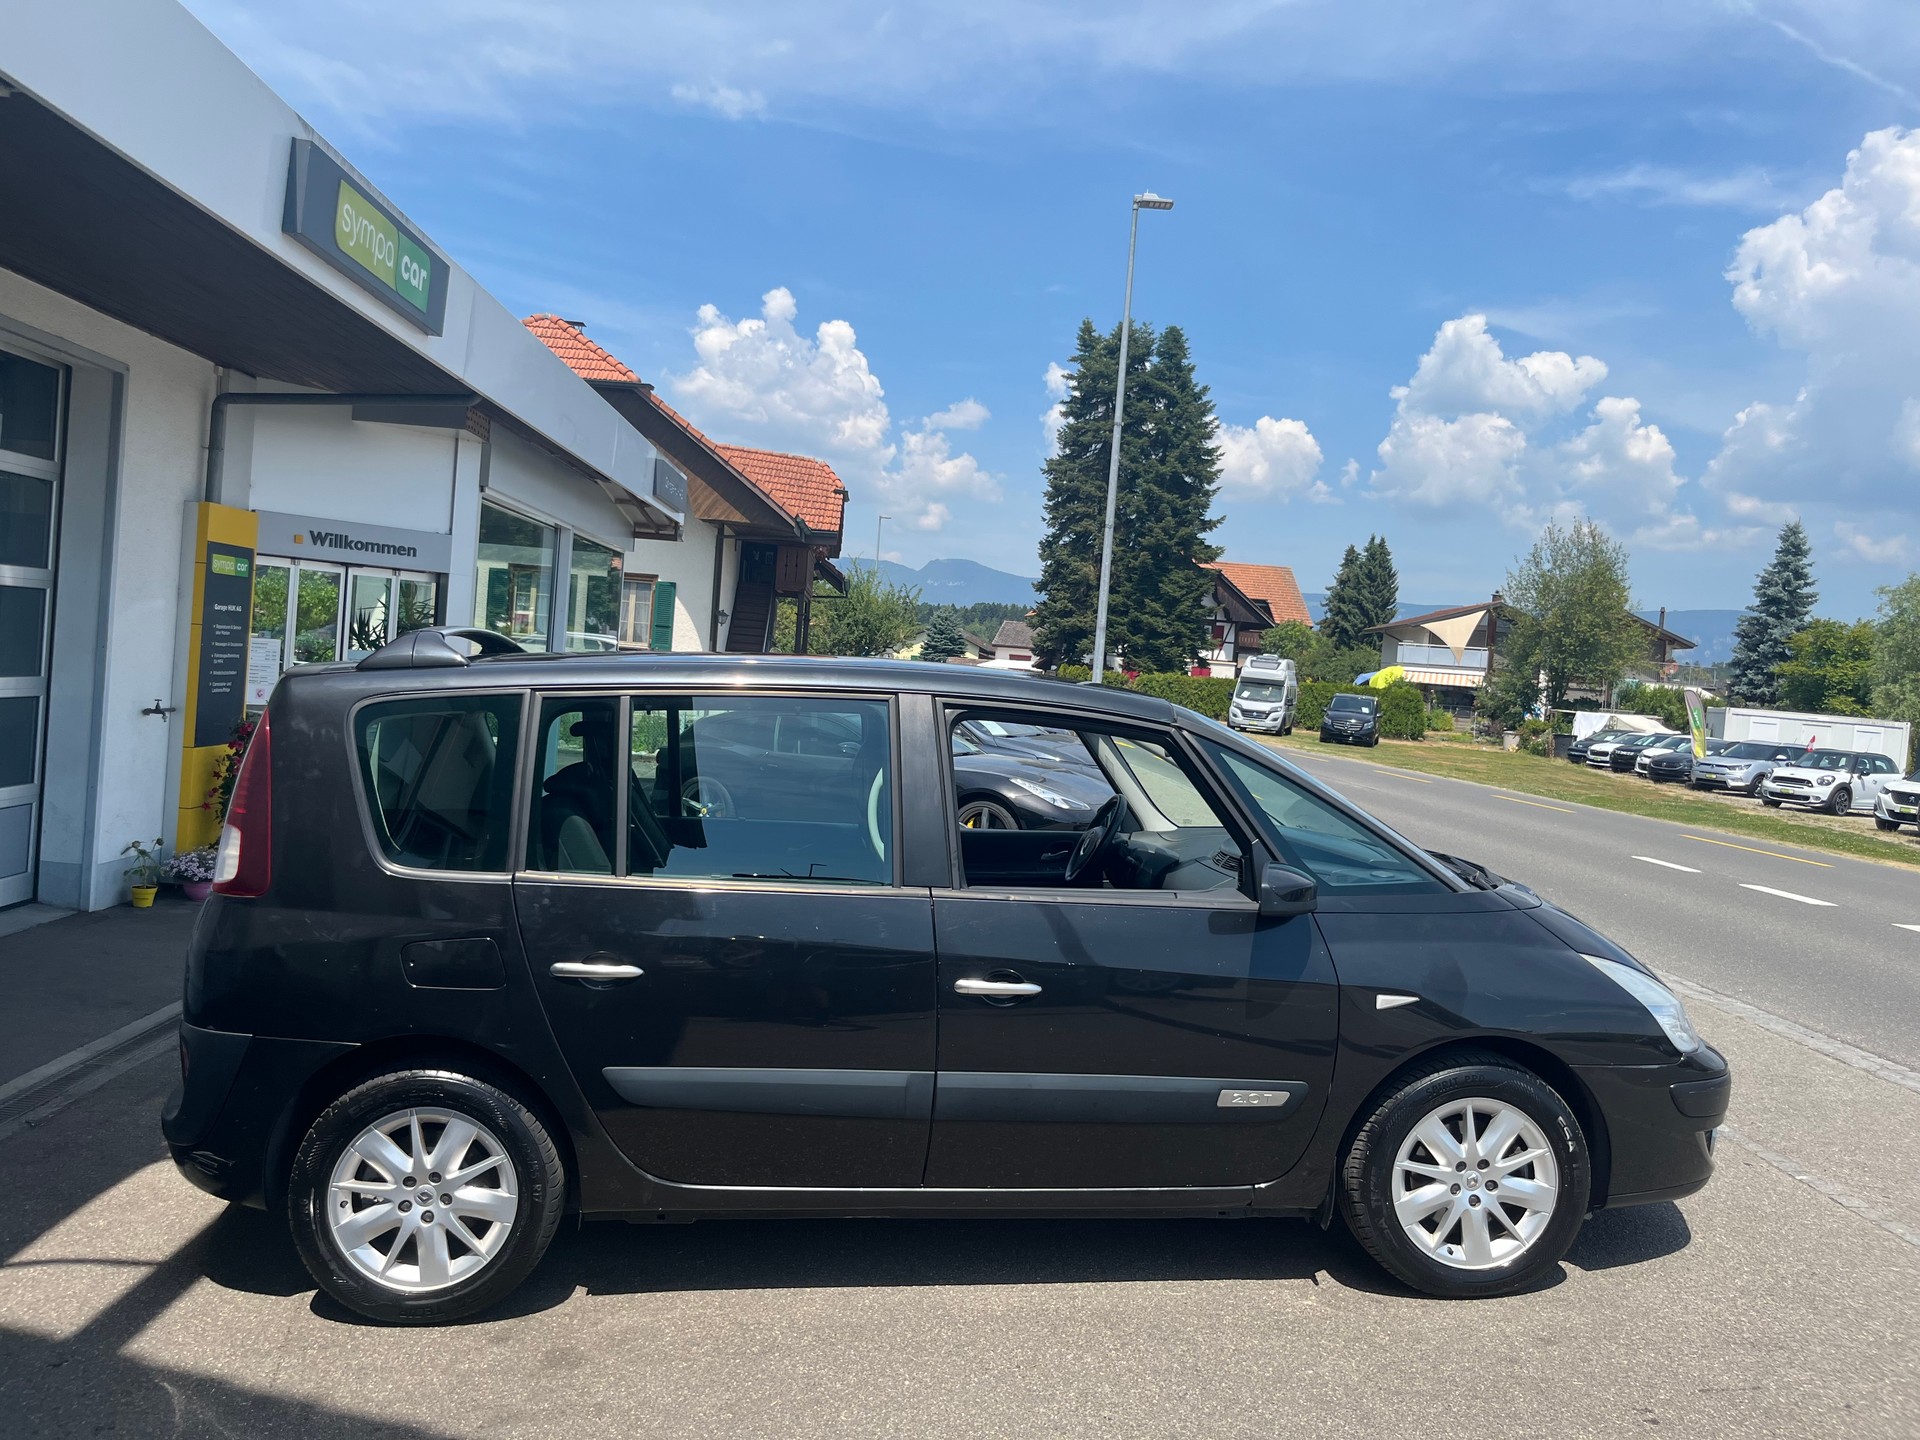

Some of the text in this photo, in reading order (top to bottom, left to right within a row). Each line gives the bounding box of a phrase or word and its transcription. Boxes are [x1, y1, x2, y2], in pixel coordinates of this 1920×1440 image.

[342, 203, 428, 291] sympa car
[309, 530, 417, 557] Willkommen
[213, 559, 248, 572] sympa car
